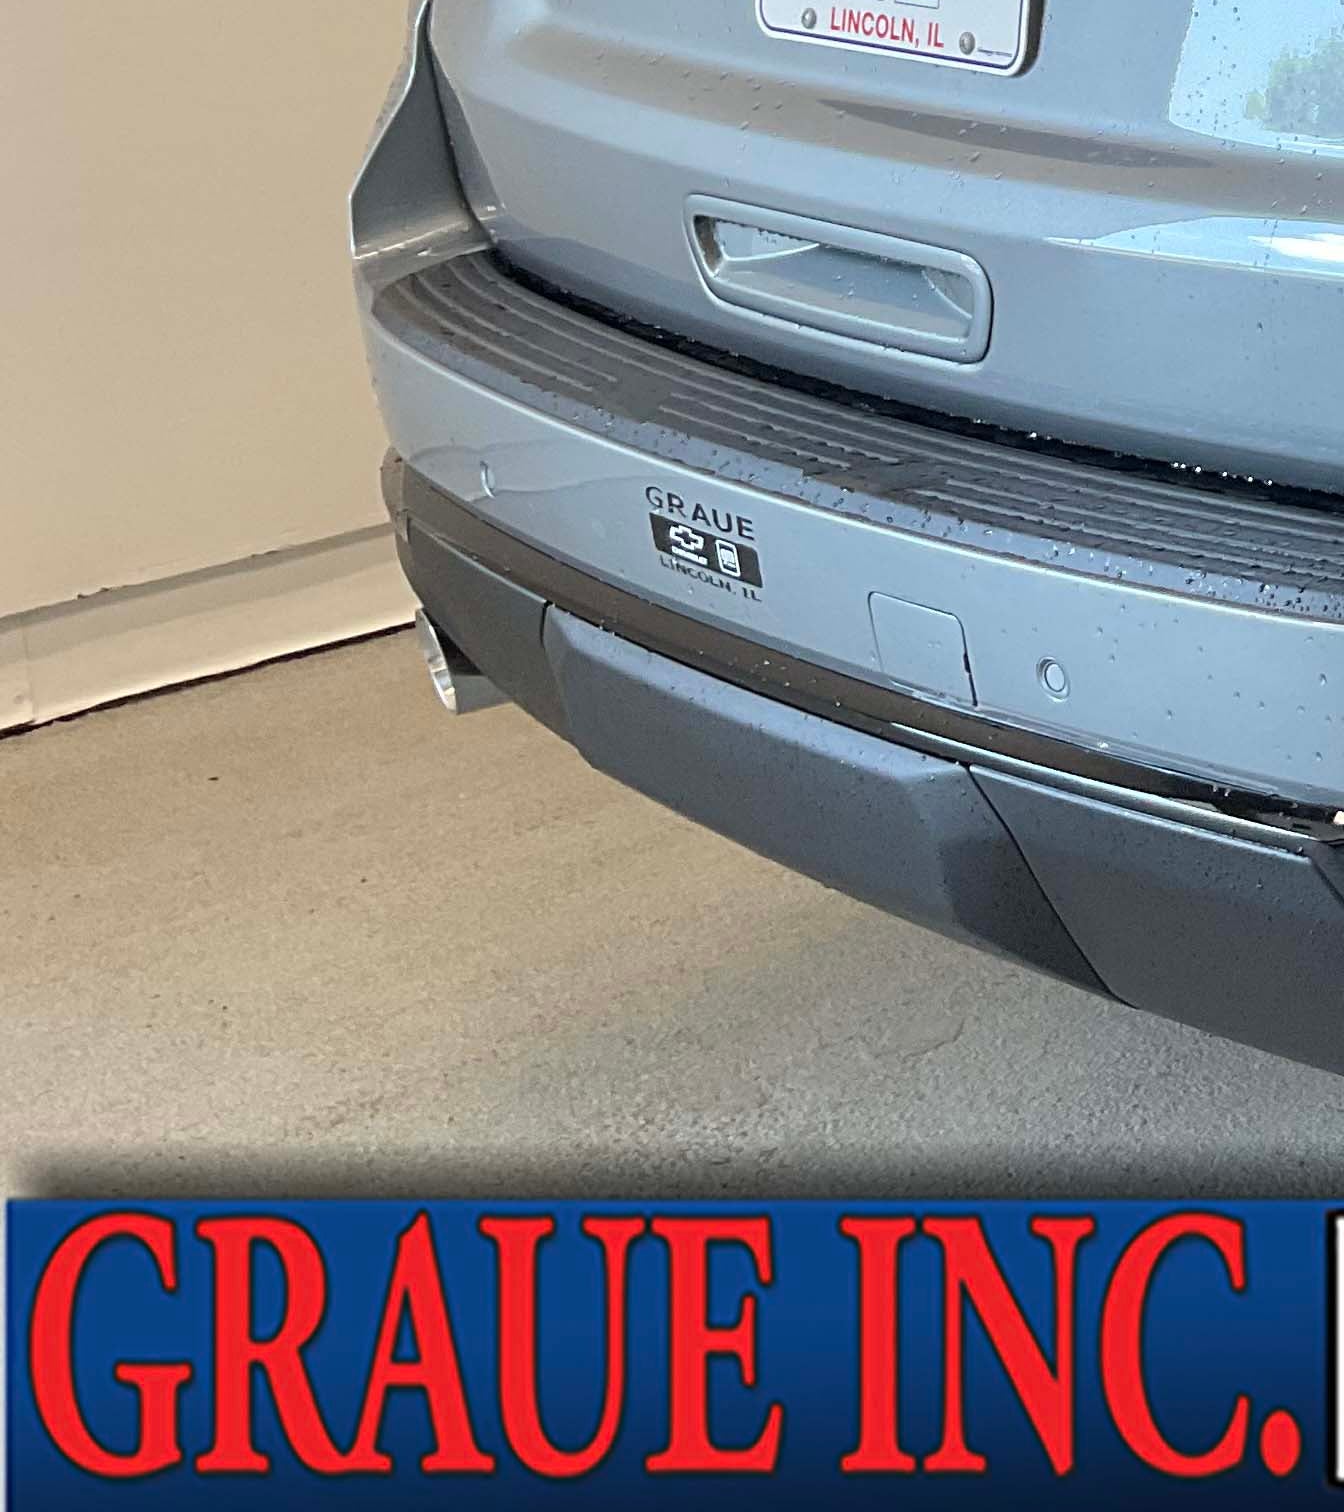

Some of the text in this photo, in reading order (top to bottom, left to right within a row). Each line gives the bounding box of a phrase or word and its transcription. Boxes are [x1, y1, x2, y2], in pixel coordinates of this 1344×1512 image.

[830, 6, 944, 48] LINCOLN, IL
[645, 486, 756, 541] GRAUE
[742, 587, 762, 602] IL
